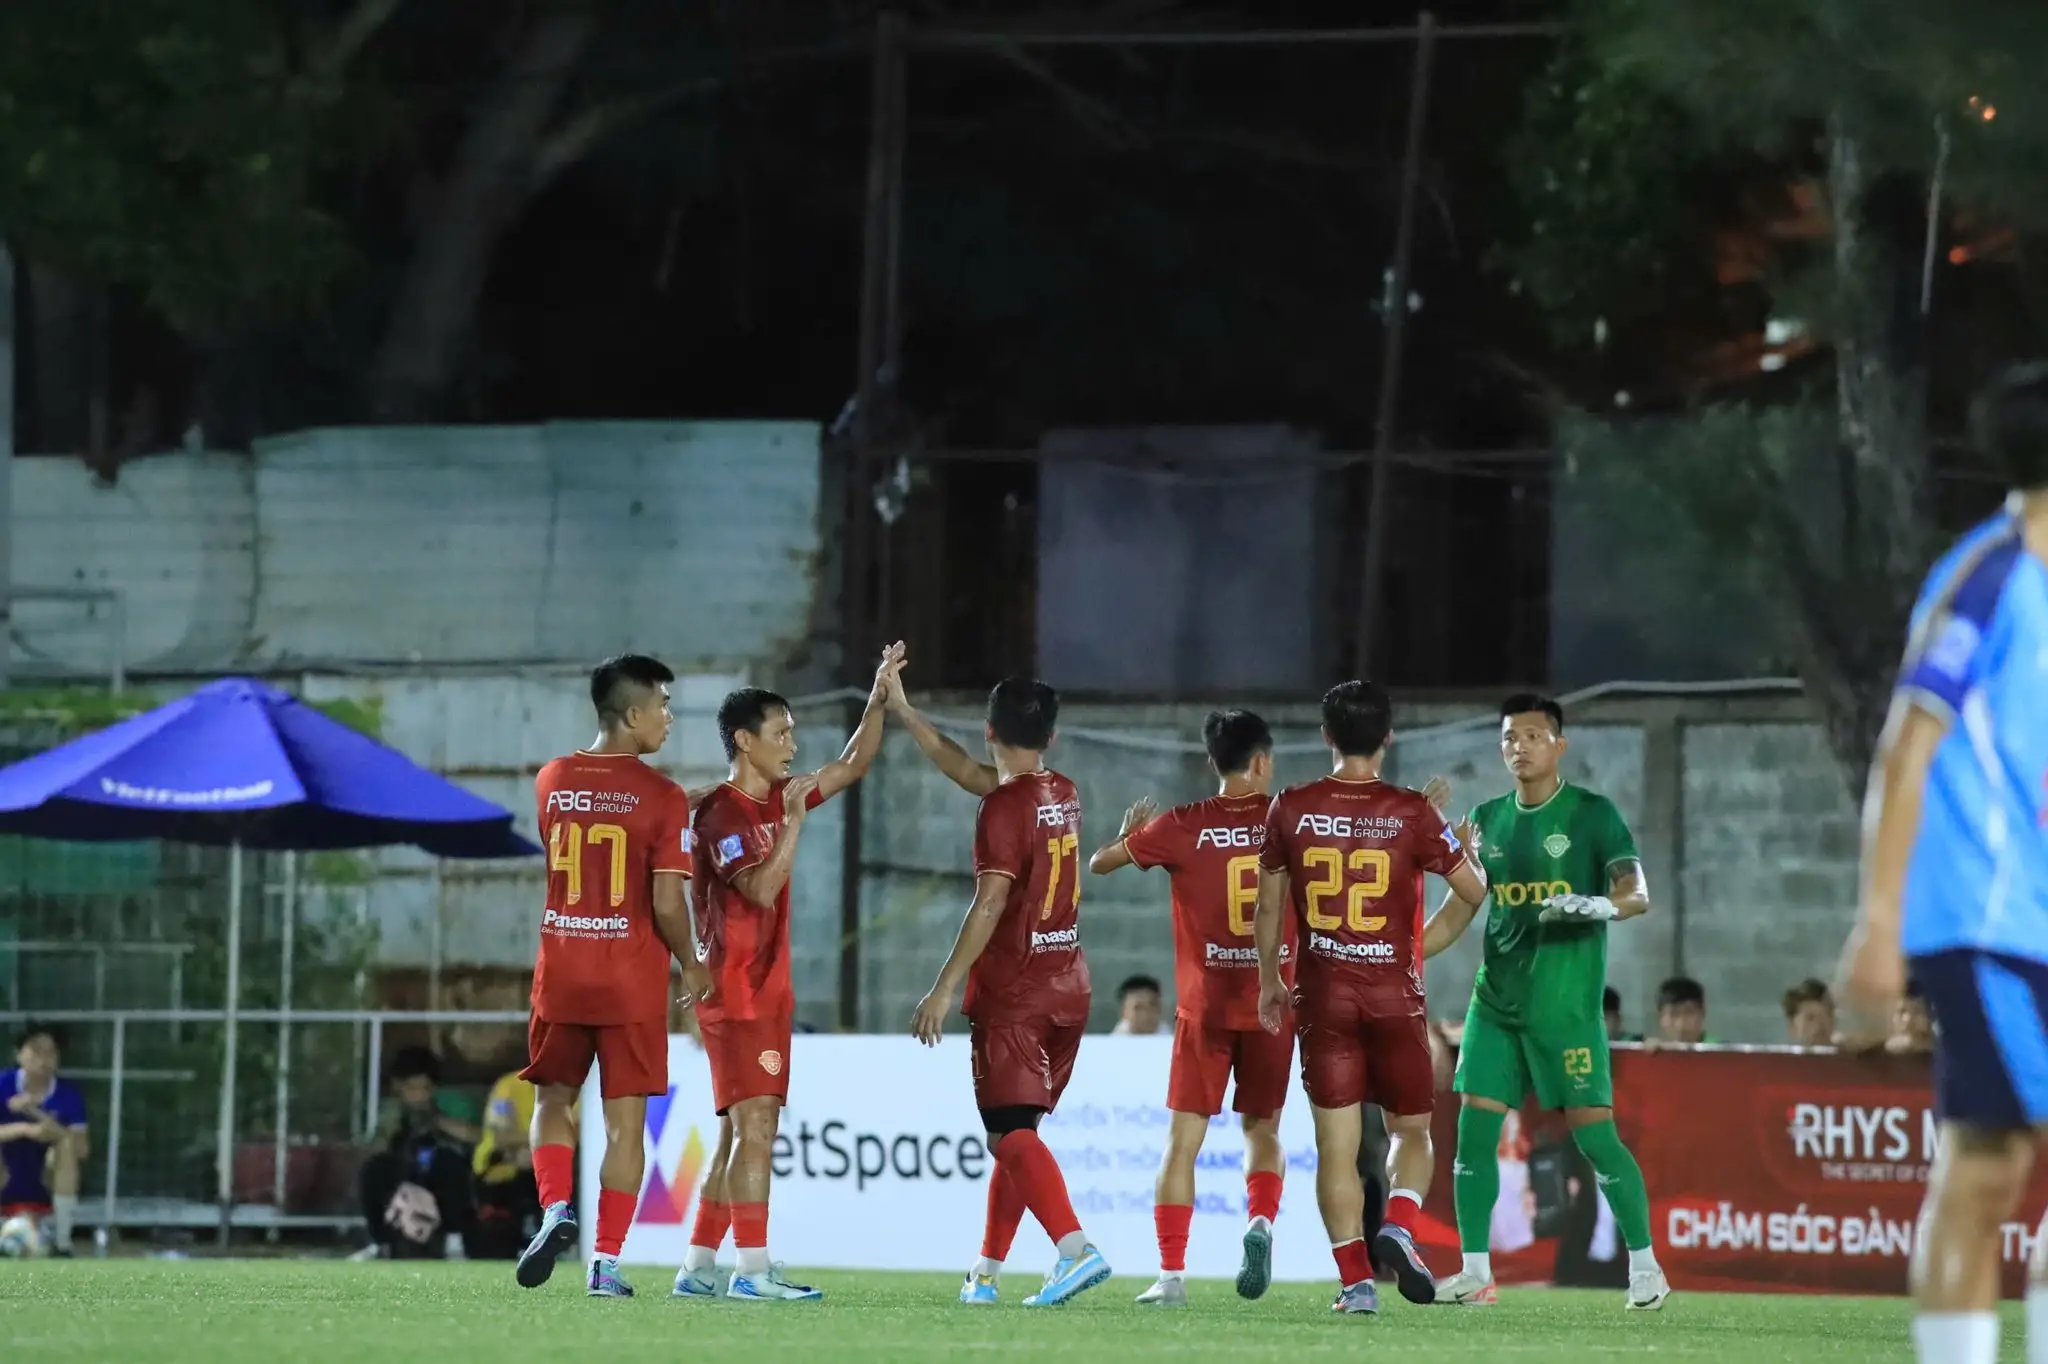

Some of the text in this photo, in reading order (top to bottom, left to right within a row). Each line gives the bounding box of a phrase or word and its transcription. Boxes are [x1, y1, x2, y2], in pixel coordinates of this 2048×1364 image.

[546, 790, 593, 813] ABG
[595, 791, 611, 801] AN
[593, 802, 633, 814] GROUP
[1295, 813, 1351, 837] ABG
[1355, 817, 1374, 827] AN
[1354, 828, 1398, 840] GROUP
[1196, 827, 1250, 849] ABG
[550, 822, 627, 907] 47
[1303, 846, 1391, 931] 22
[543, 909, 629, 930] Panasonic
[1309, 932, 1394, 956] Panasonic
[1563, 1047, 1592, 1075] 23
[1792, 1102, 1910, 1161] RHYS
[772, 1120, 985, 1191] etSpace
[1668, 1202, 1764, 1252] CHĂM
[1767, 1203, 1836, 1254] SÓC
[1840, 1207, 1912, 1257] ĐÀN
